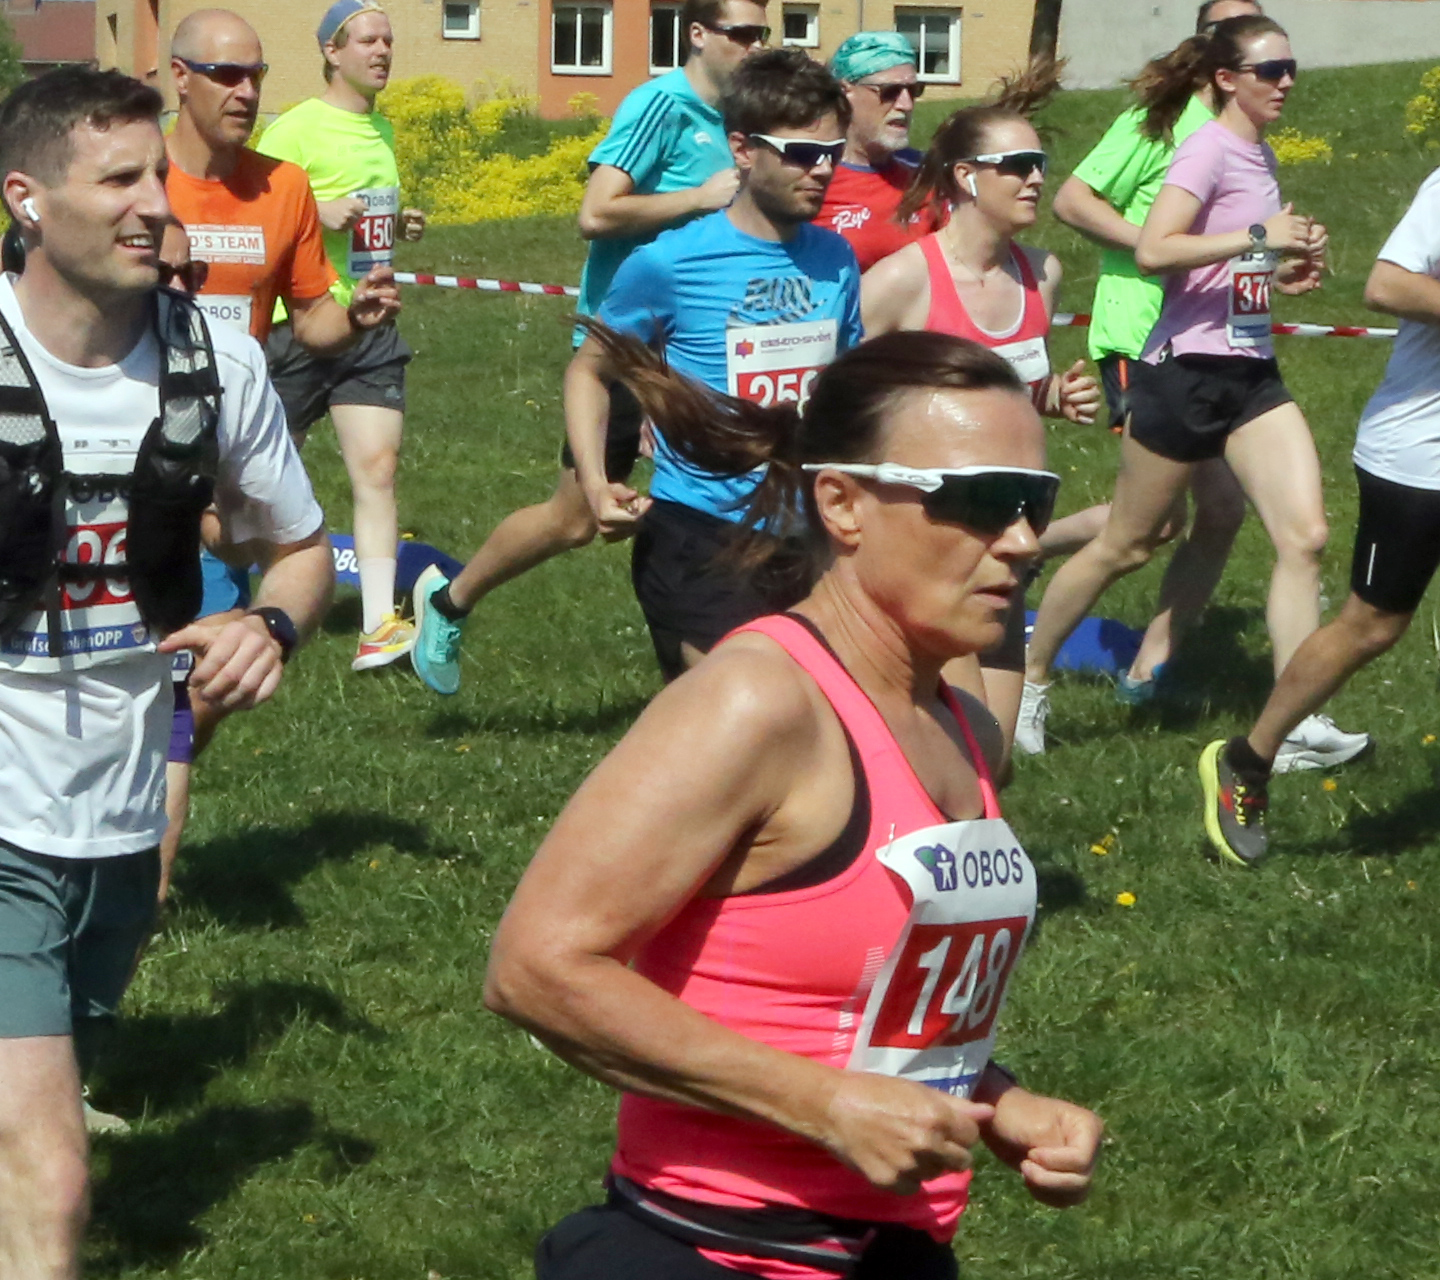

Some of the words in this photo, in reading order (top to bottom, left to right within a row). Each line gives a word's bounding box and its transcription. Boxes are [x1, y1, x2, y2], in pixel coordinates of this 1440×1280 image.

[218, 236, 260, 250] TEAM
[360, 217, 394, 249] 150
[200, 305, 242, 320] BOS
[963, 847, 1024, 888] OBOS
[907, 927, 1012, 1036] 148
